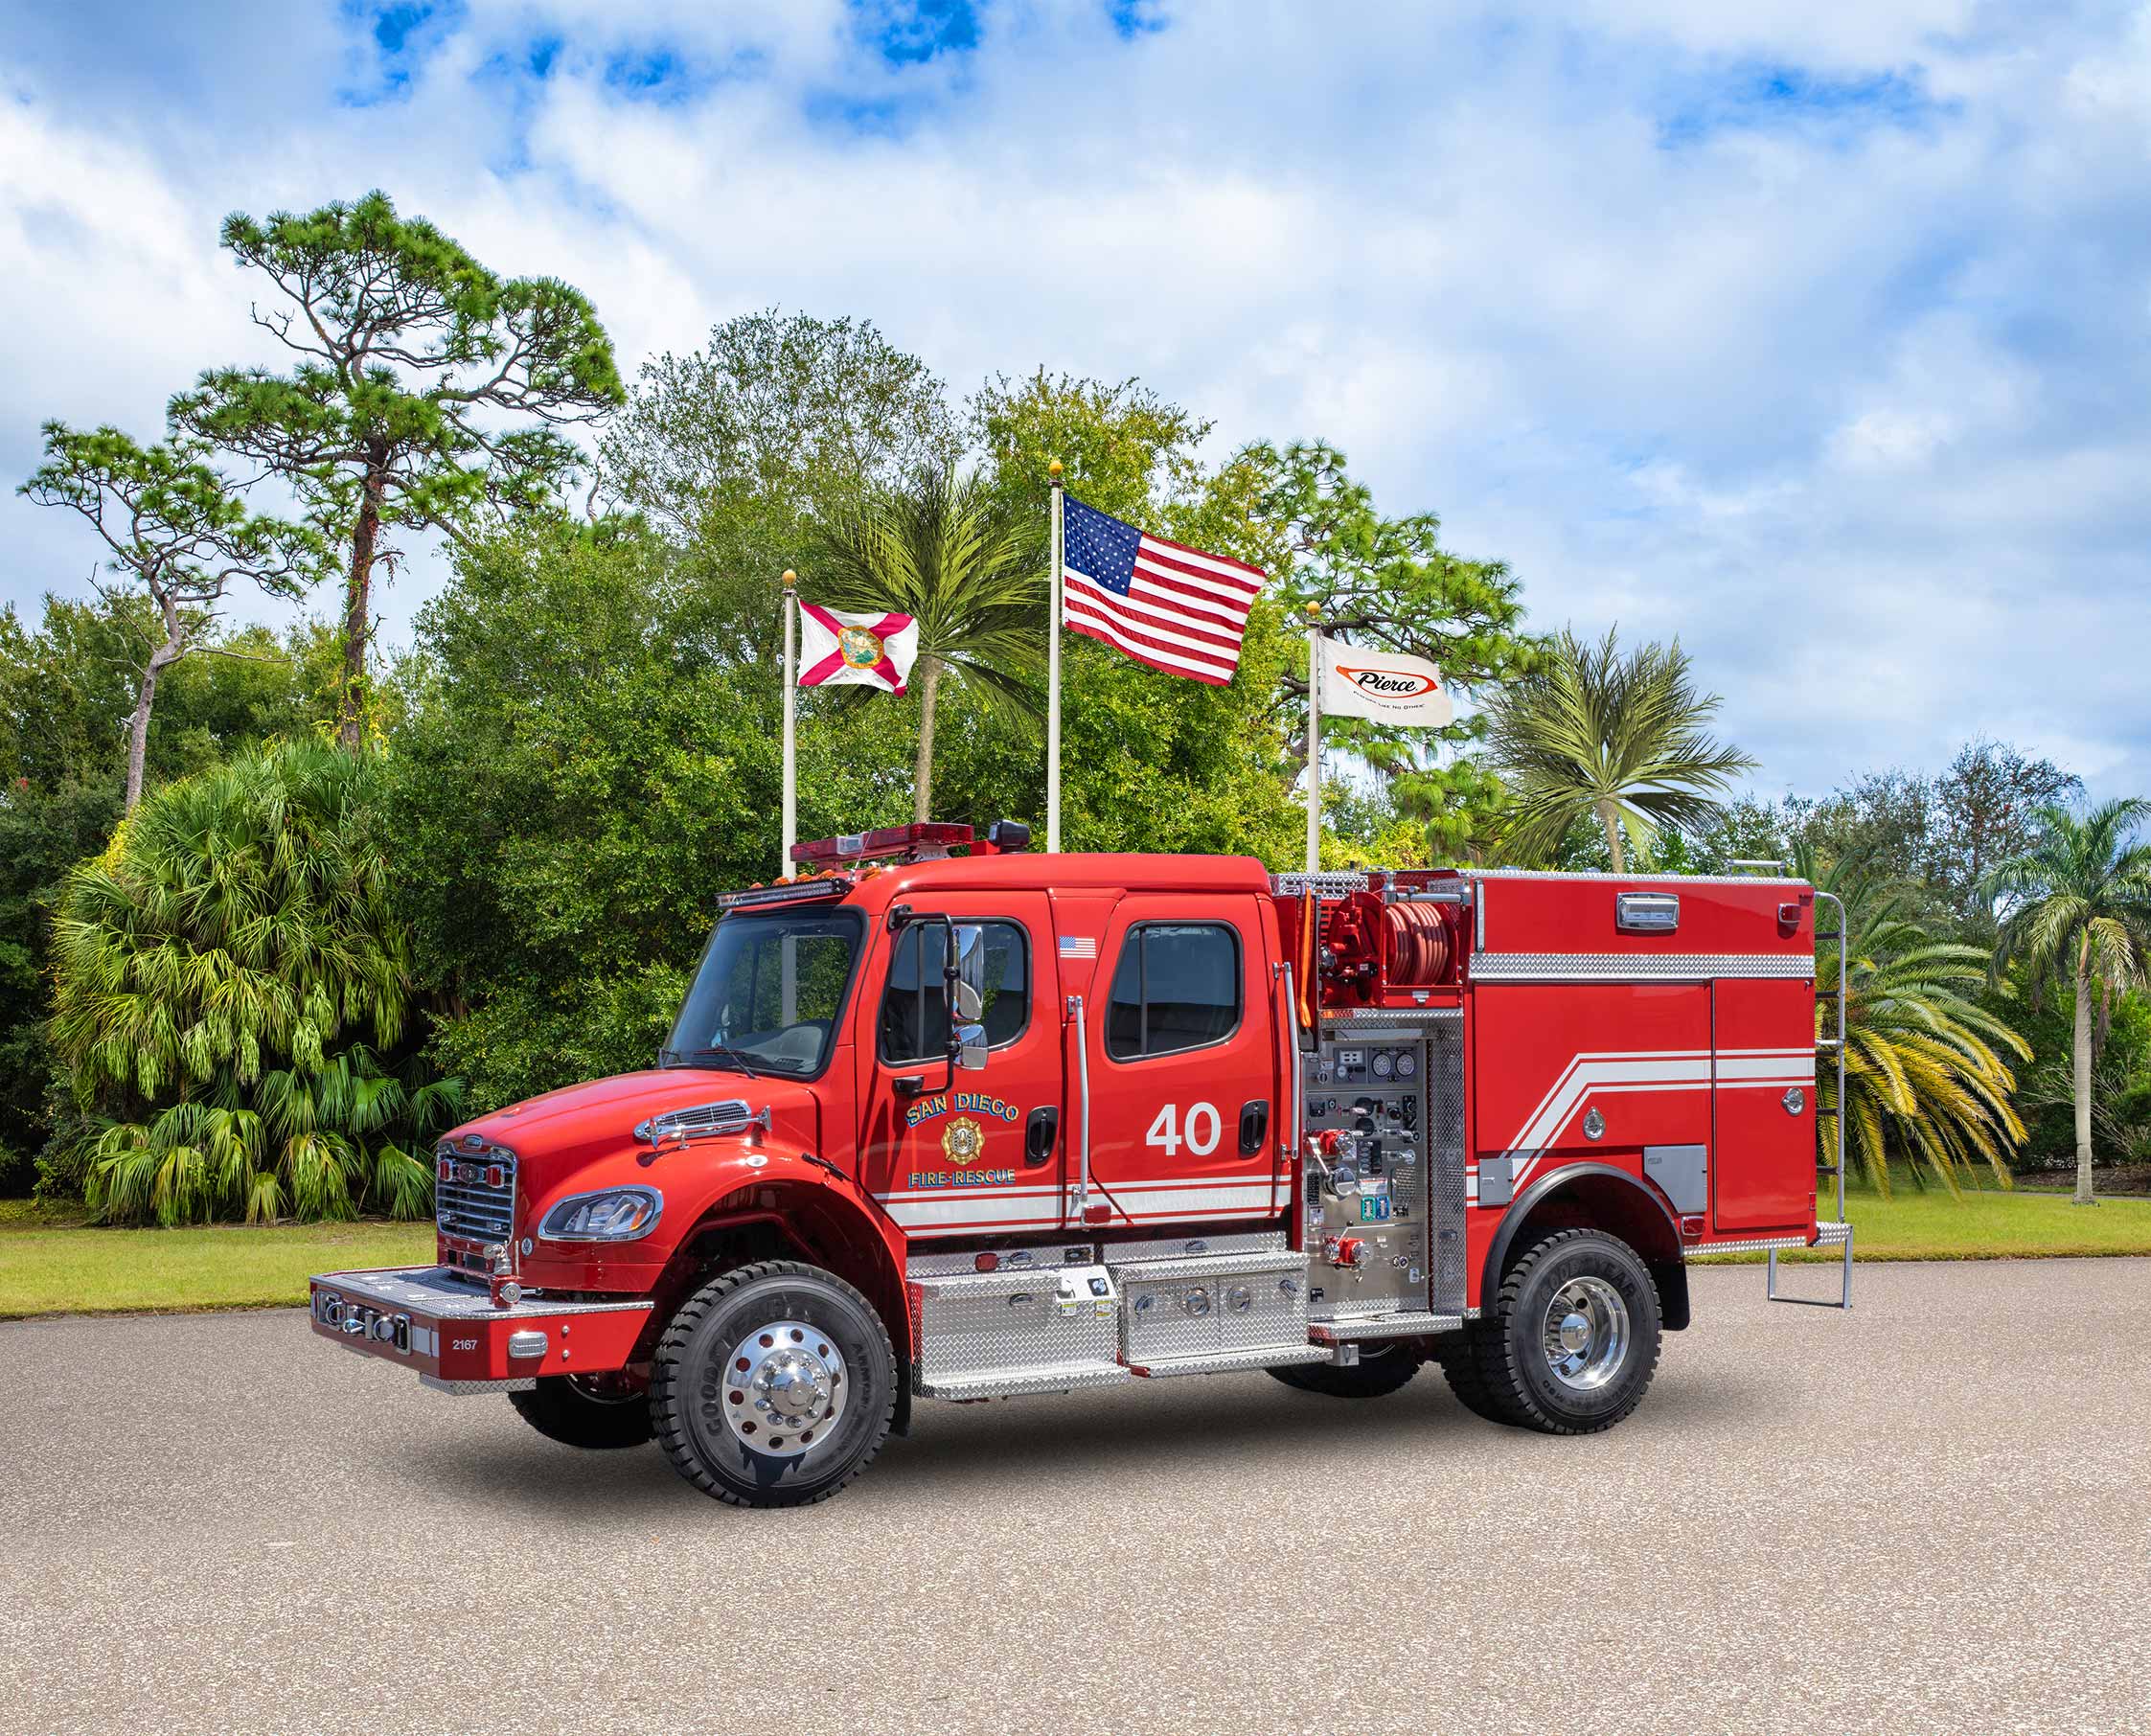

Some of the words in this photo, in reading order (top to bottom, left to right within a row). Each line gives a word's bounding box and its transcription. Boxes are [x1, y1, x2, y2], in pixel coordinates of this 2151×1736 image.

[1358, 672, 1416, 692] Pierce
[905, 1095, 948, 1128] SAN
[953, 1092, 1019, 1123] DIEGO
[1146, 1101, 1222, 1156] 40
[908, 1169, 1017, 1189] FIRE-RESCUE
[452, 1339, 478, 1350] 2167
